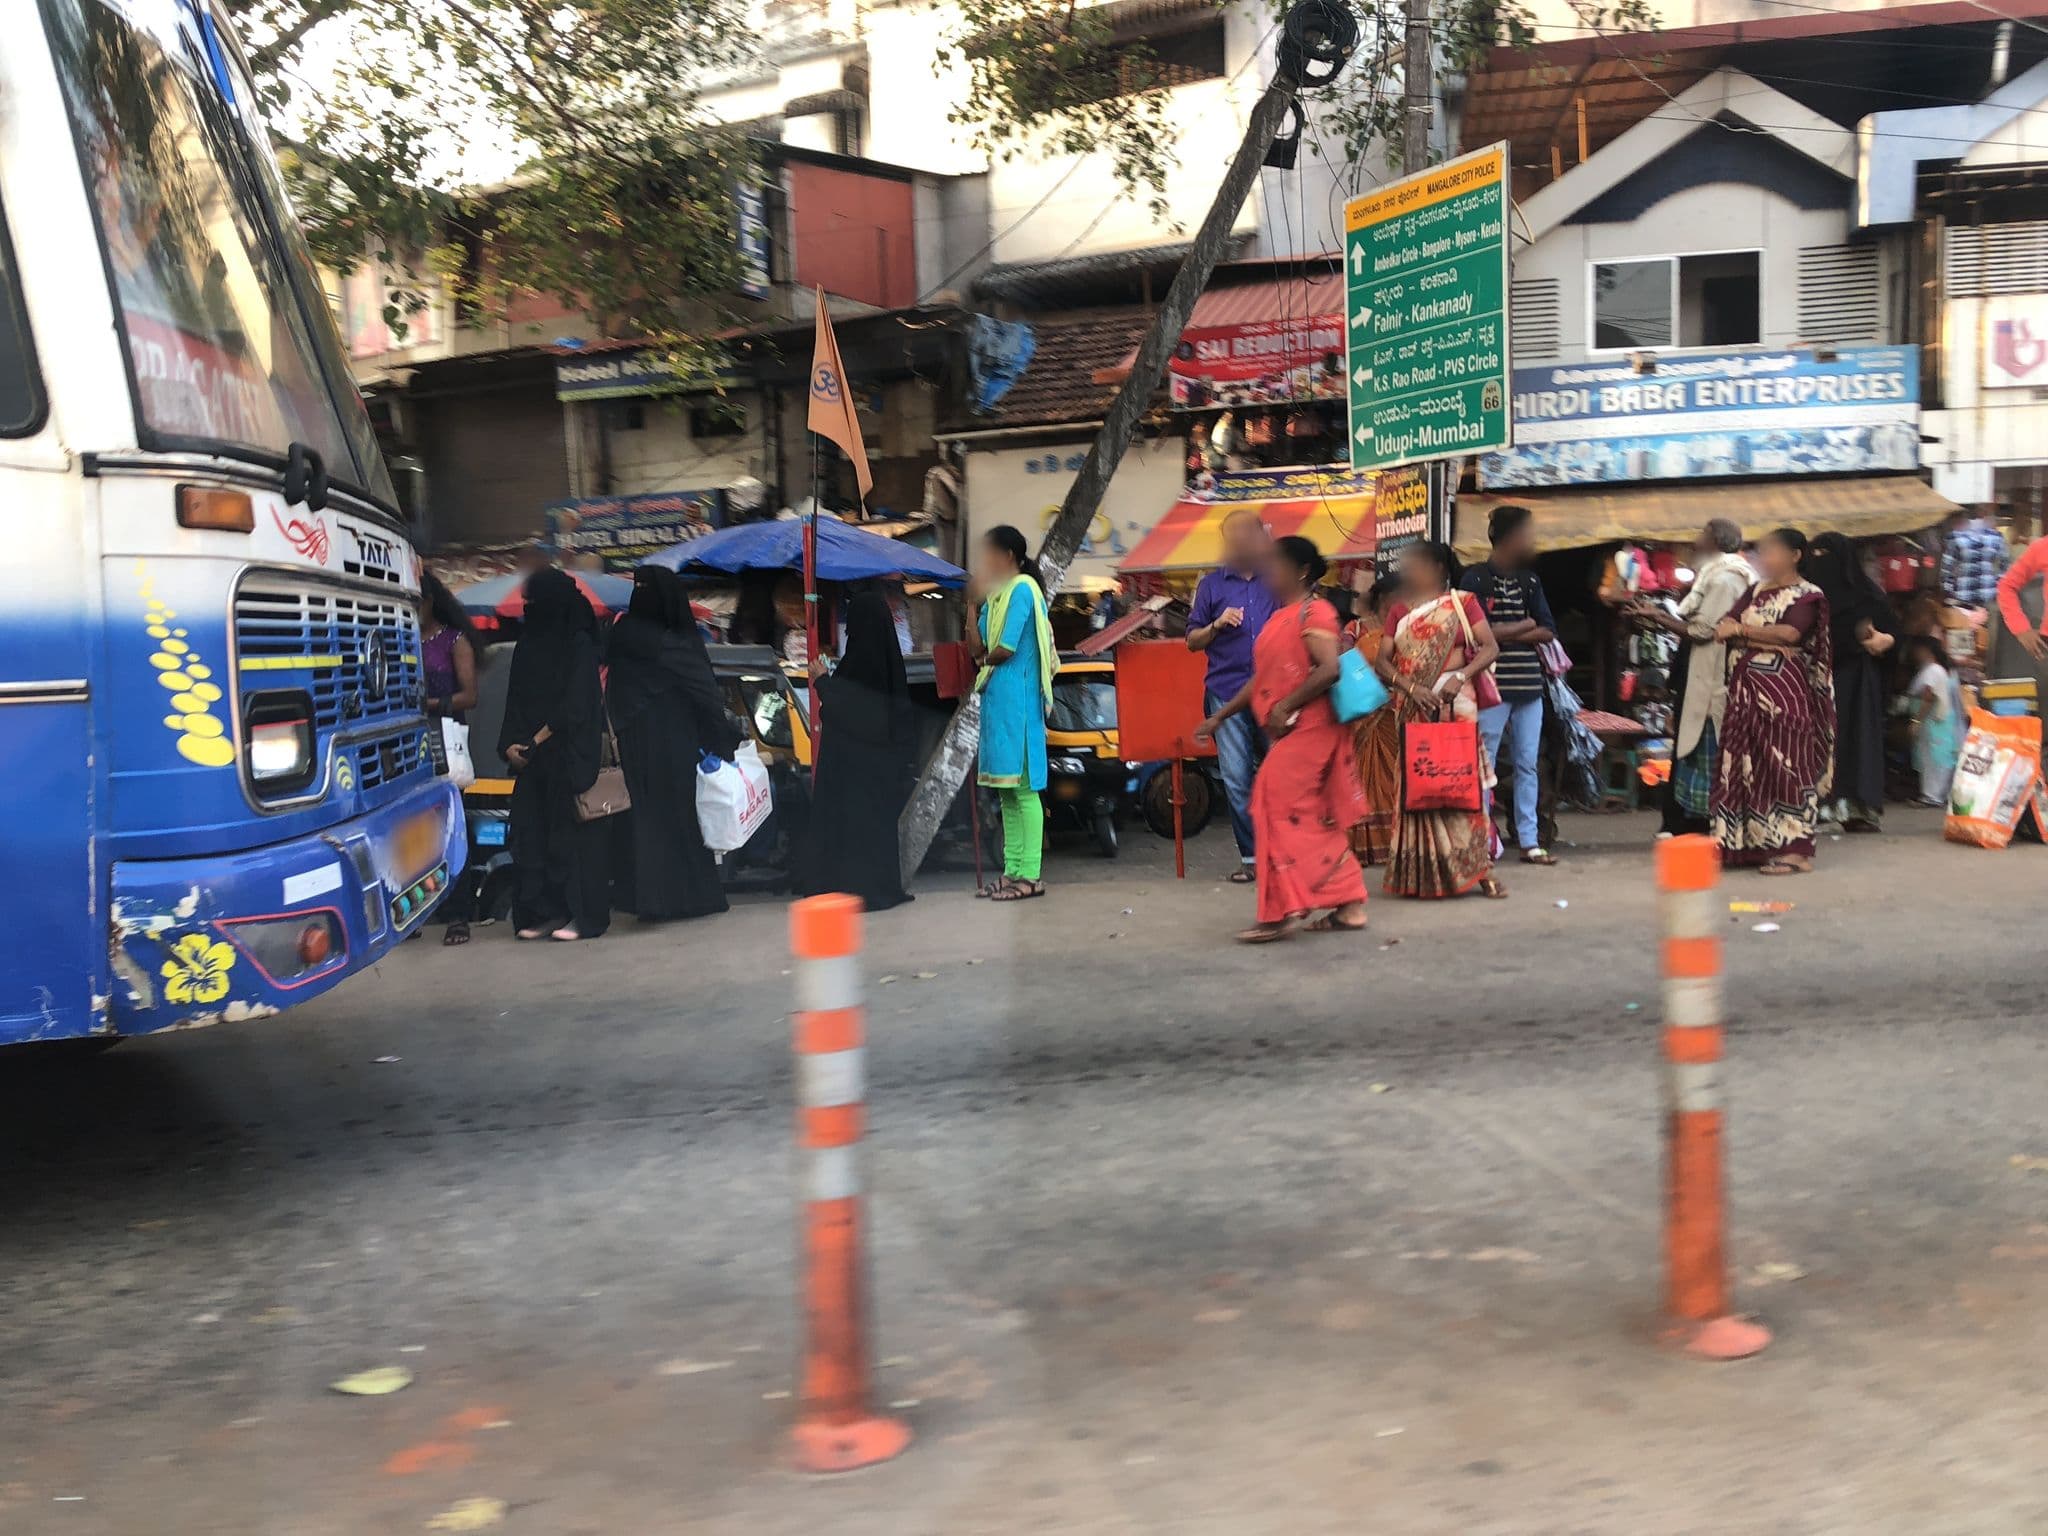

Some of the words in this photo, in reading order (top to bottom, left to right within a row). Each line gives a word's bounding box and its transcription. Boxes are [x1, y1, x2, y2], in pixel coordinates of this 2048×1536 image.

[1426, 173, 1461, 195] MANGALORE
[1461, 167, 1474, 184] CITY
[1474, 161, 1496, 180] POLICE
[1374, 250, 1401, 273] Ambedkar
[1401, 246, 1418, 264] Circle
[1422, 236, 1451, 258] Bangalore
[1455, 229, 1477, 250] Mysore
[1480, 219, 1501, 240] Kerala
[1374, 309, 1403, 334] Falnir
[1411, 290, 1473, 324] Kankanady
[1195, 338, 1230, 360] SAI
[1373, 374, 1390, 393] K.S.
[1392, 371, 1410, 390] Rao
[1411, 363, 1437, 385] Road
[1444, 356, 1465, 378] PVS
[1468, 350, 1499, 373] Circle
[1484, 395, 1500, 410] 66
[1513, 387, 1590, 420] HIRDI
[1599, 382, 1689, 414] BABA
[1694, 371, 1907, 407] ENTERPRISES
[1374, 416, 1485, 459] Udupi-Mumbai
[1375, 513, 1427, 539] ASTROLOGER
[357, 539, 392, 569] TATA
[738, 787, 769, 825] SAGAR
